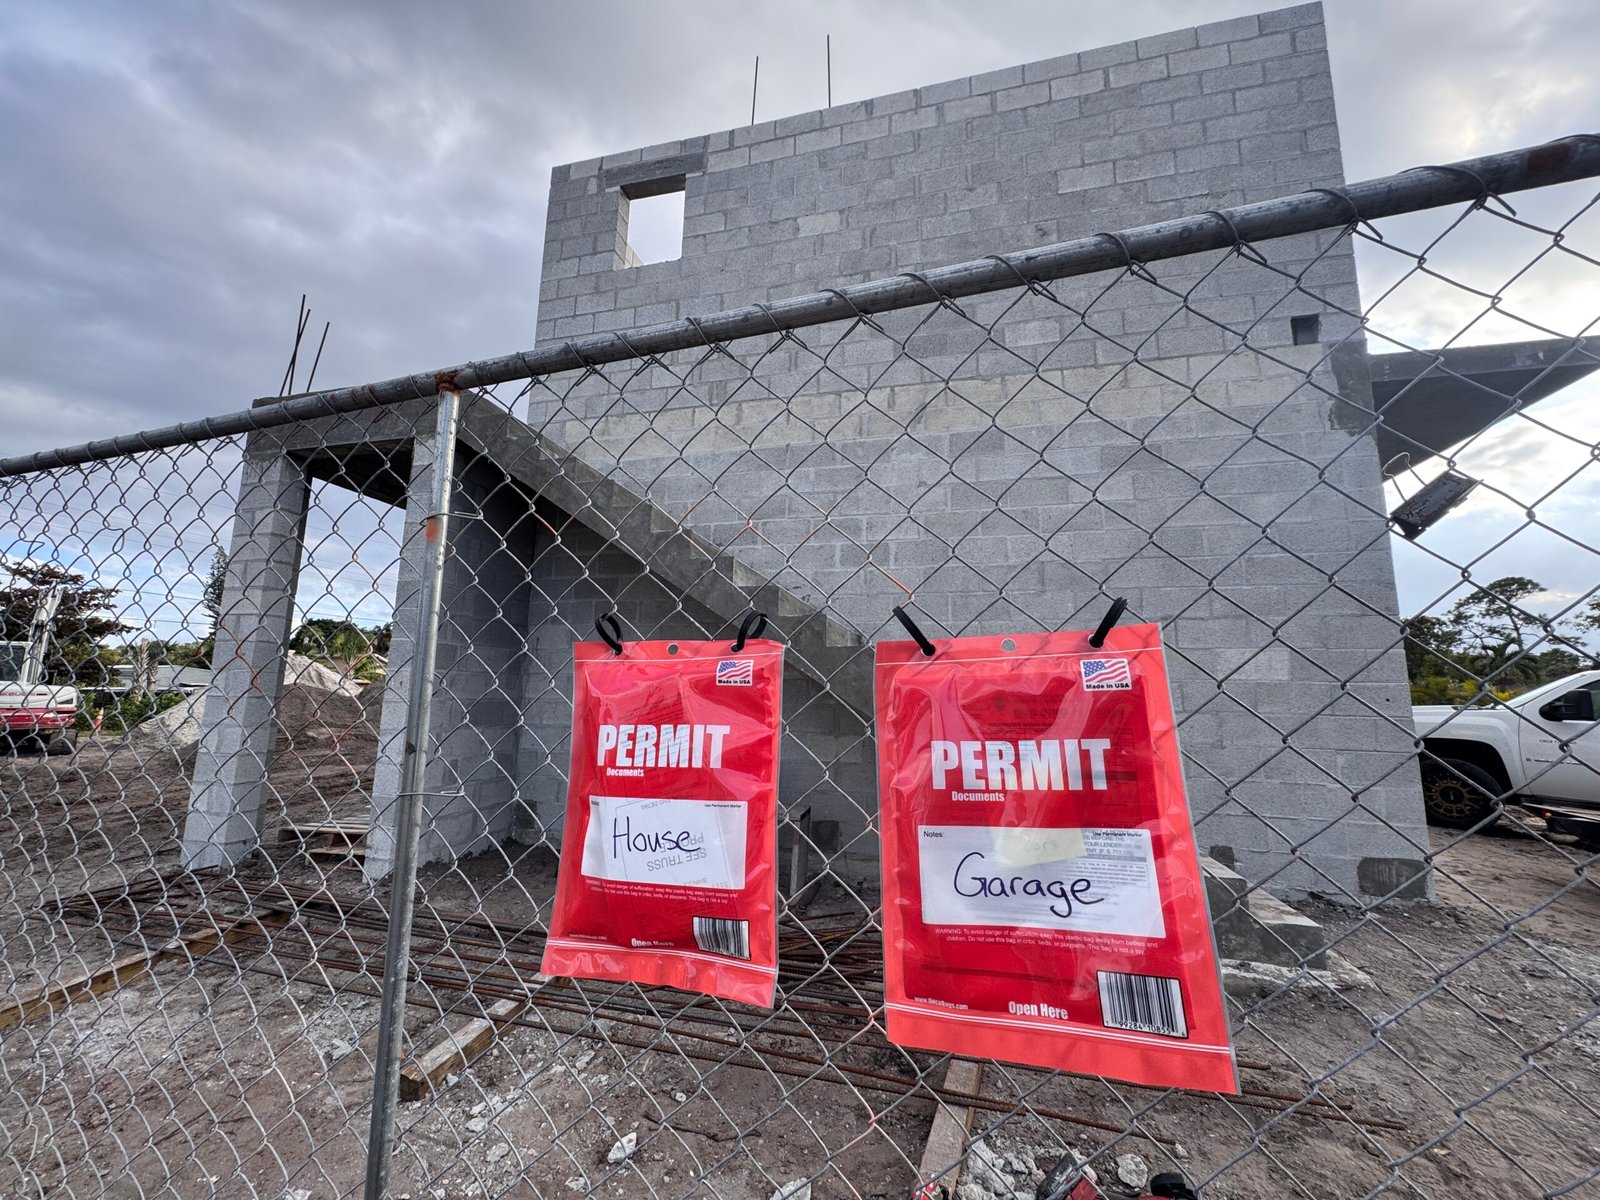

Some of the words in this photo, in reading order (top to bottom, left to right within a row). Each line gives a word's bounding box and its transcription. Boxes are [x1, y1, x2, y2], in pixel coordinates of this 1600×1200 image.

[597, 724, 731, 769] PERMIT
[606, 767, 644, 776] Documents
[930, 738, 1111, 791] PERMIT
[951, 791, 1005, 802] Documents
[613, 816, 700, 859] House
[660, 832, 704, 854] PROLE
[646, 854, 683, 872] TRUSS
[953, 852, 1104, 918] Garage
[1008, 1001, 1038, 1016] Open
[1040, 1003, 1068, 1019] Here
[1119, 1020, 1143, 1030] 99284
[1147, 1025, 1171, 1034] 10855
